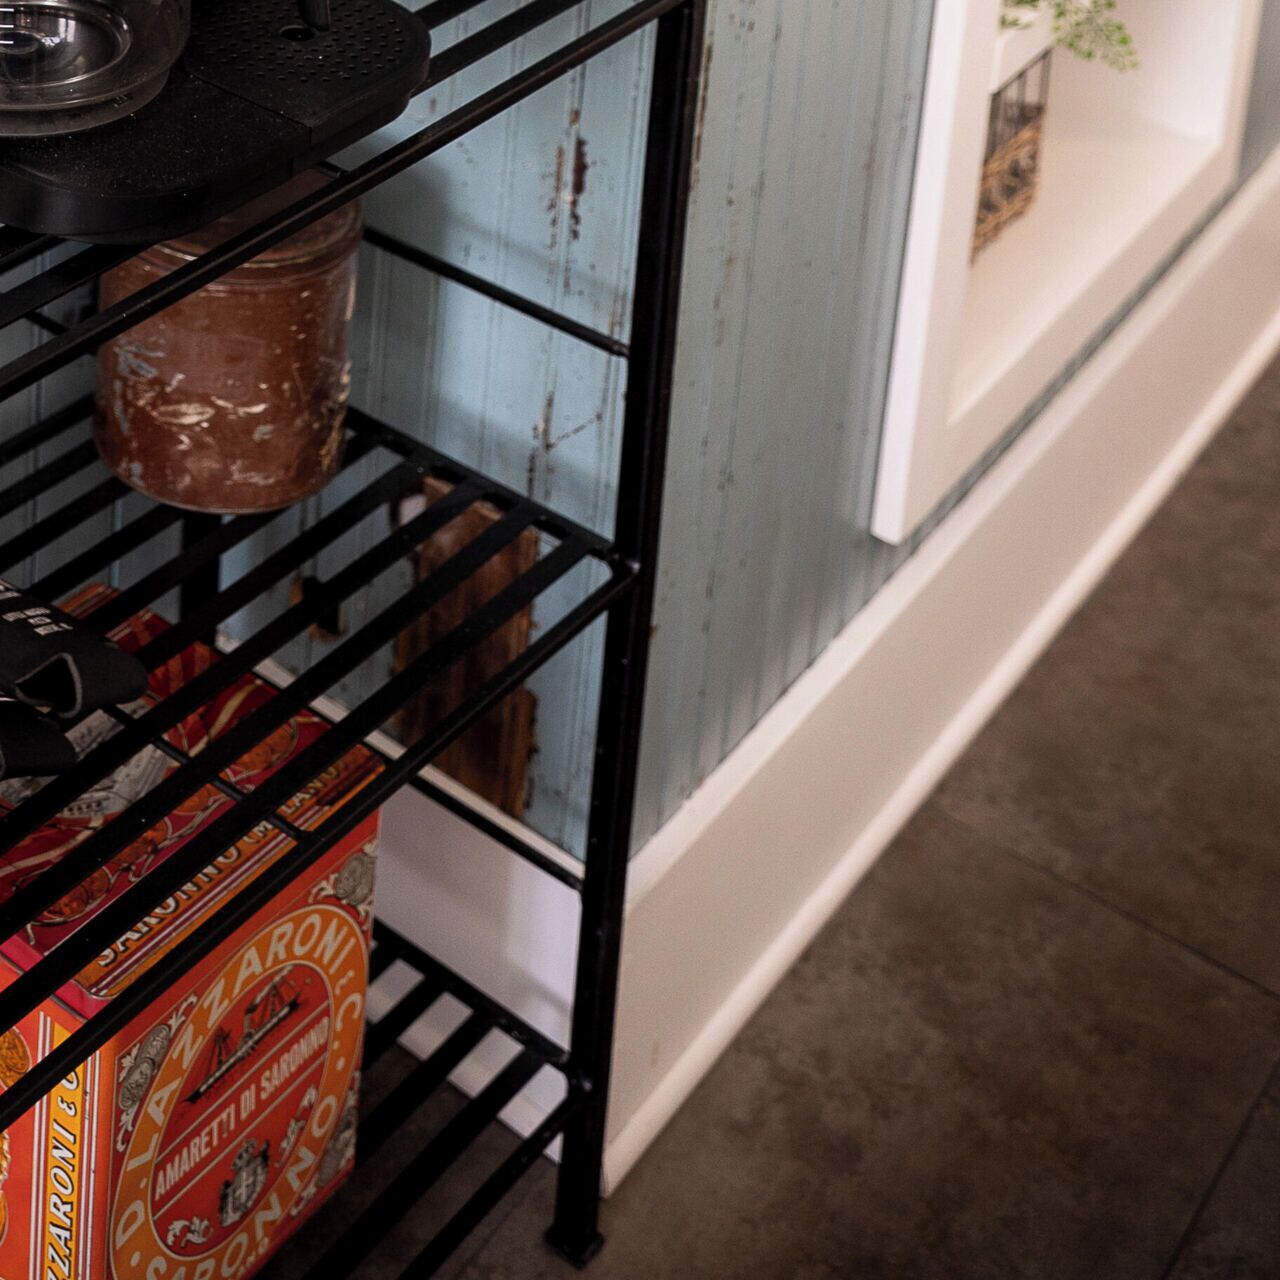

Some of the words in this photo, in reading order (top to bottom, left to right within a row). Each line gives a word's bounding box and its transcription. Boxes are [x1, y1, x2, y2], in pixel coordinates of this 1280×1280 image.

[153, 1102, 237, 1201] AMARETTI
[240, 1083, 257, 1121] DI
[259, 1016, 330, 1100] SARONNO
